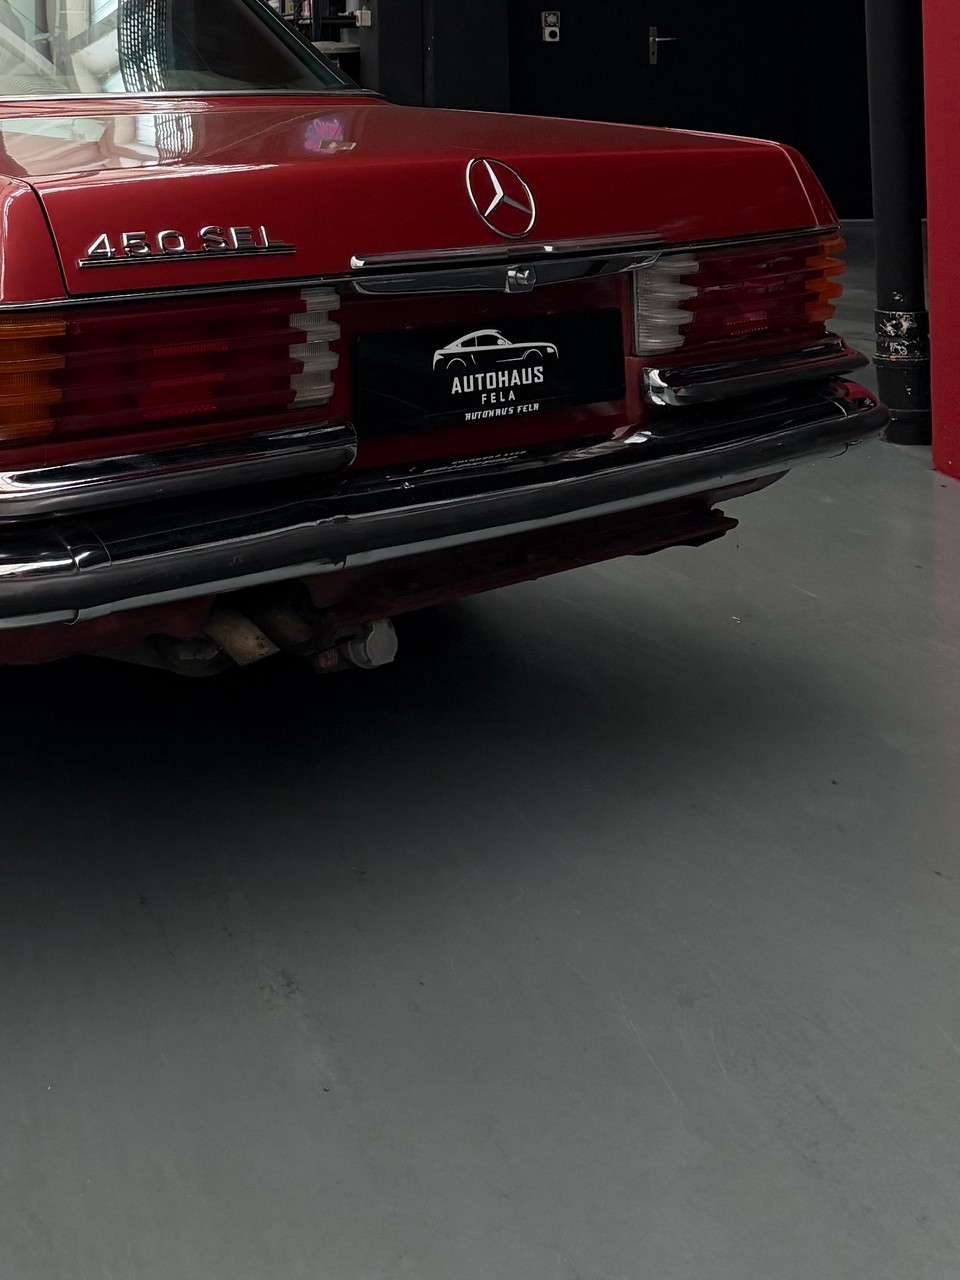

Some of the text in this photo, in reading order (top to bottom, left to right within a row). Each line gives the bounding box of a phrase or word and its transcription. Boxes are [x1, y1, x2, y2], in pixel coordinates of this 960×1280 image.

[86, 225, 286, 259] 450 SEL
[451, 366, 544, 394] AUTOHAUS
[481, 390, 516, 405] FELA
[465, 403, 540, 421] AUTOHAUS FELA
